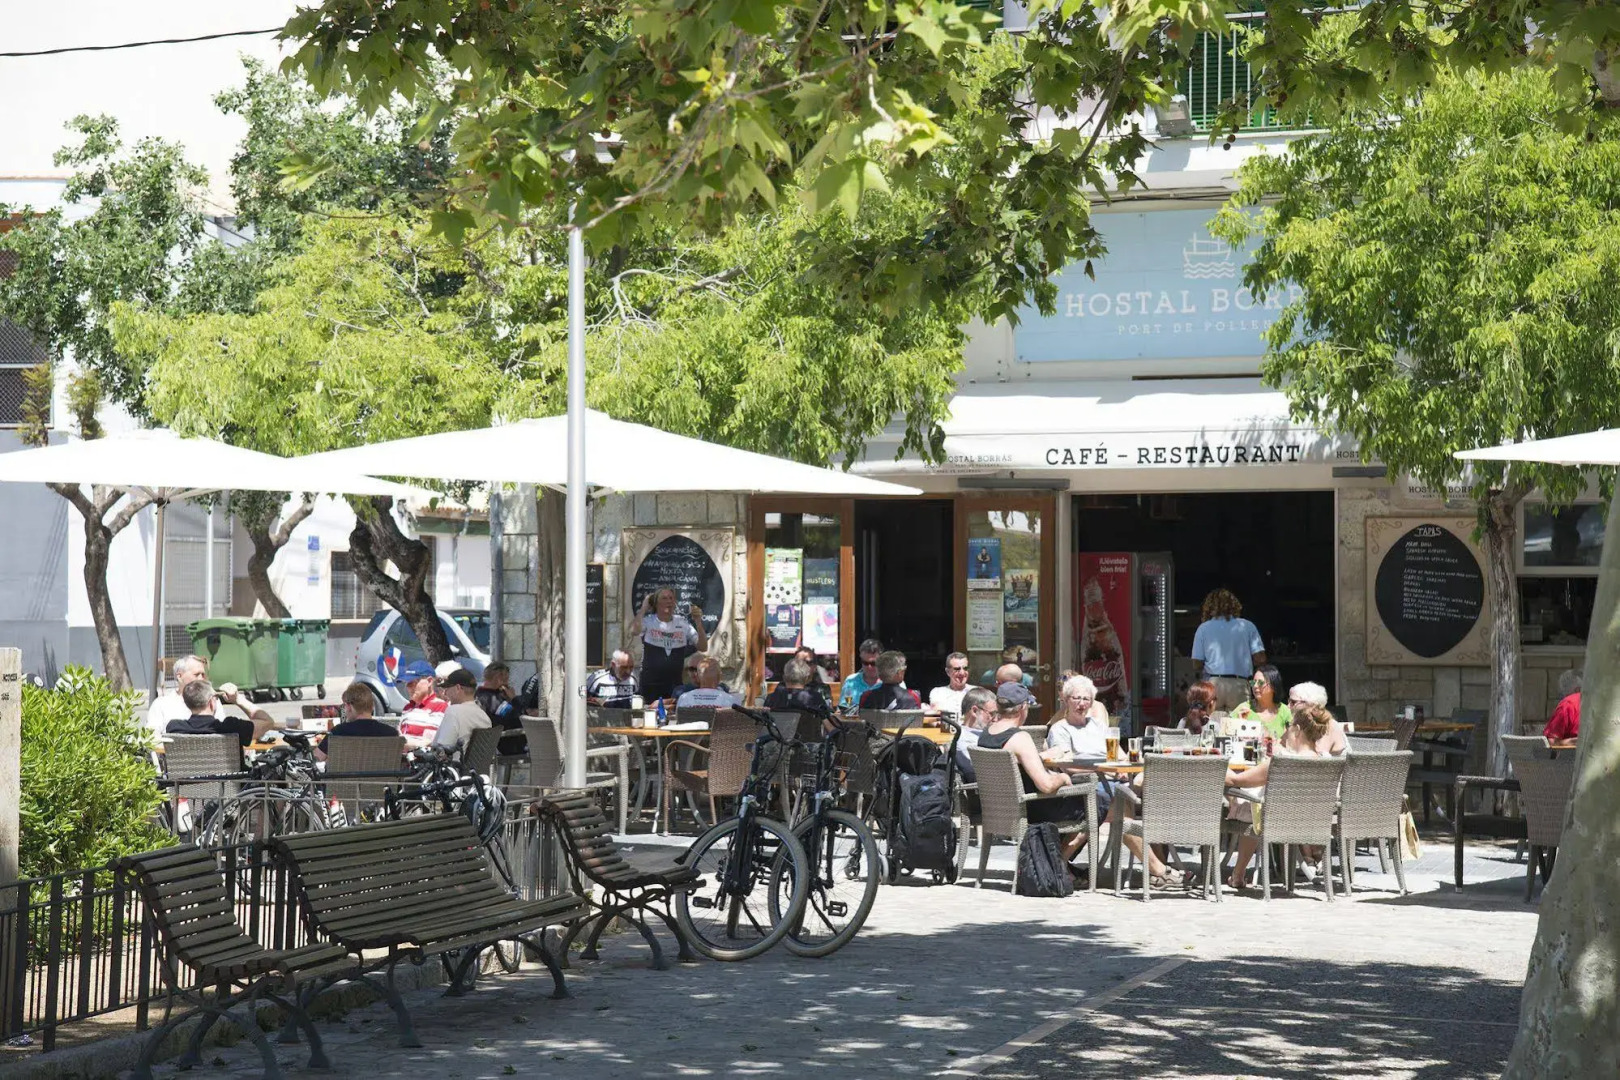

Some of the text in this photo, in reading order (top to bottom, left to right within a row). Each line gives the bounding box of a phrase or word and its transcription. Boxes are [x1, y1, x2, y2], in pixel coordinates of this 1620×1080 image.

[1064, 284, 1305, 317] HOSTAL BORR
[1117, 319, 1273, 335] PORT DE POLLEN
[947, 455, 975, 463] OSTAL
[1045, 442, 1108, 465] CAFÉ
[1136, 445, 1300, 465] RESTAURANT
[1336, 451, 1359, 459] HOST
[1417, 527, 1442, 536] TAPAS
